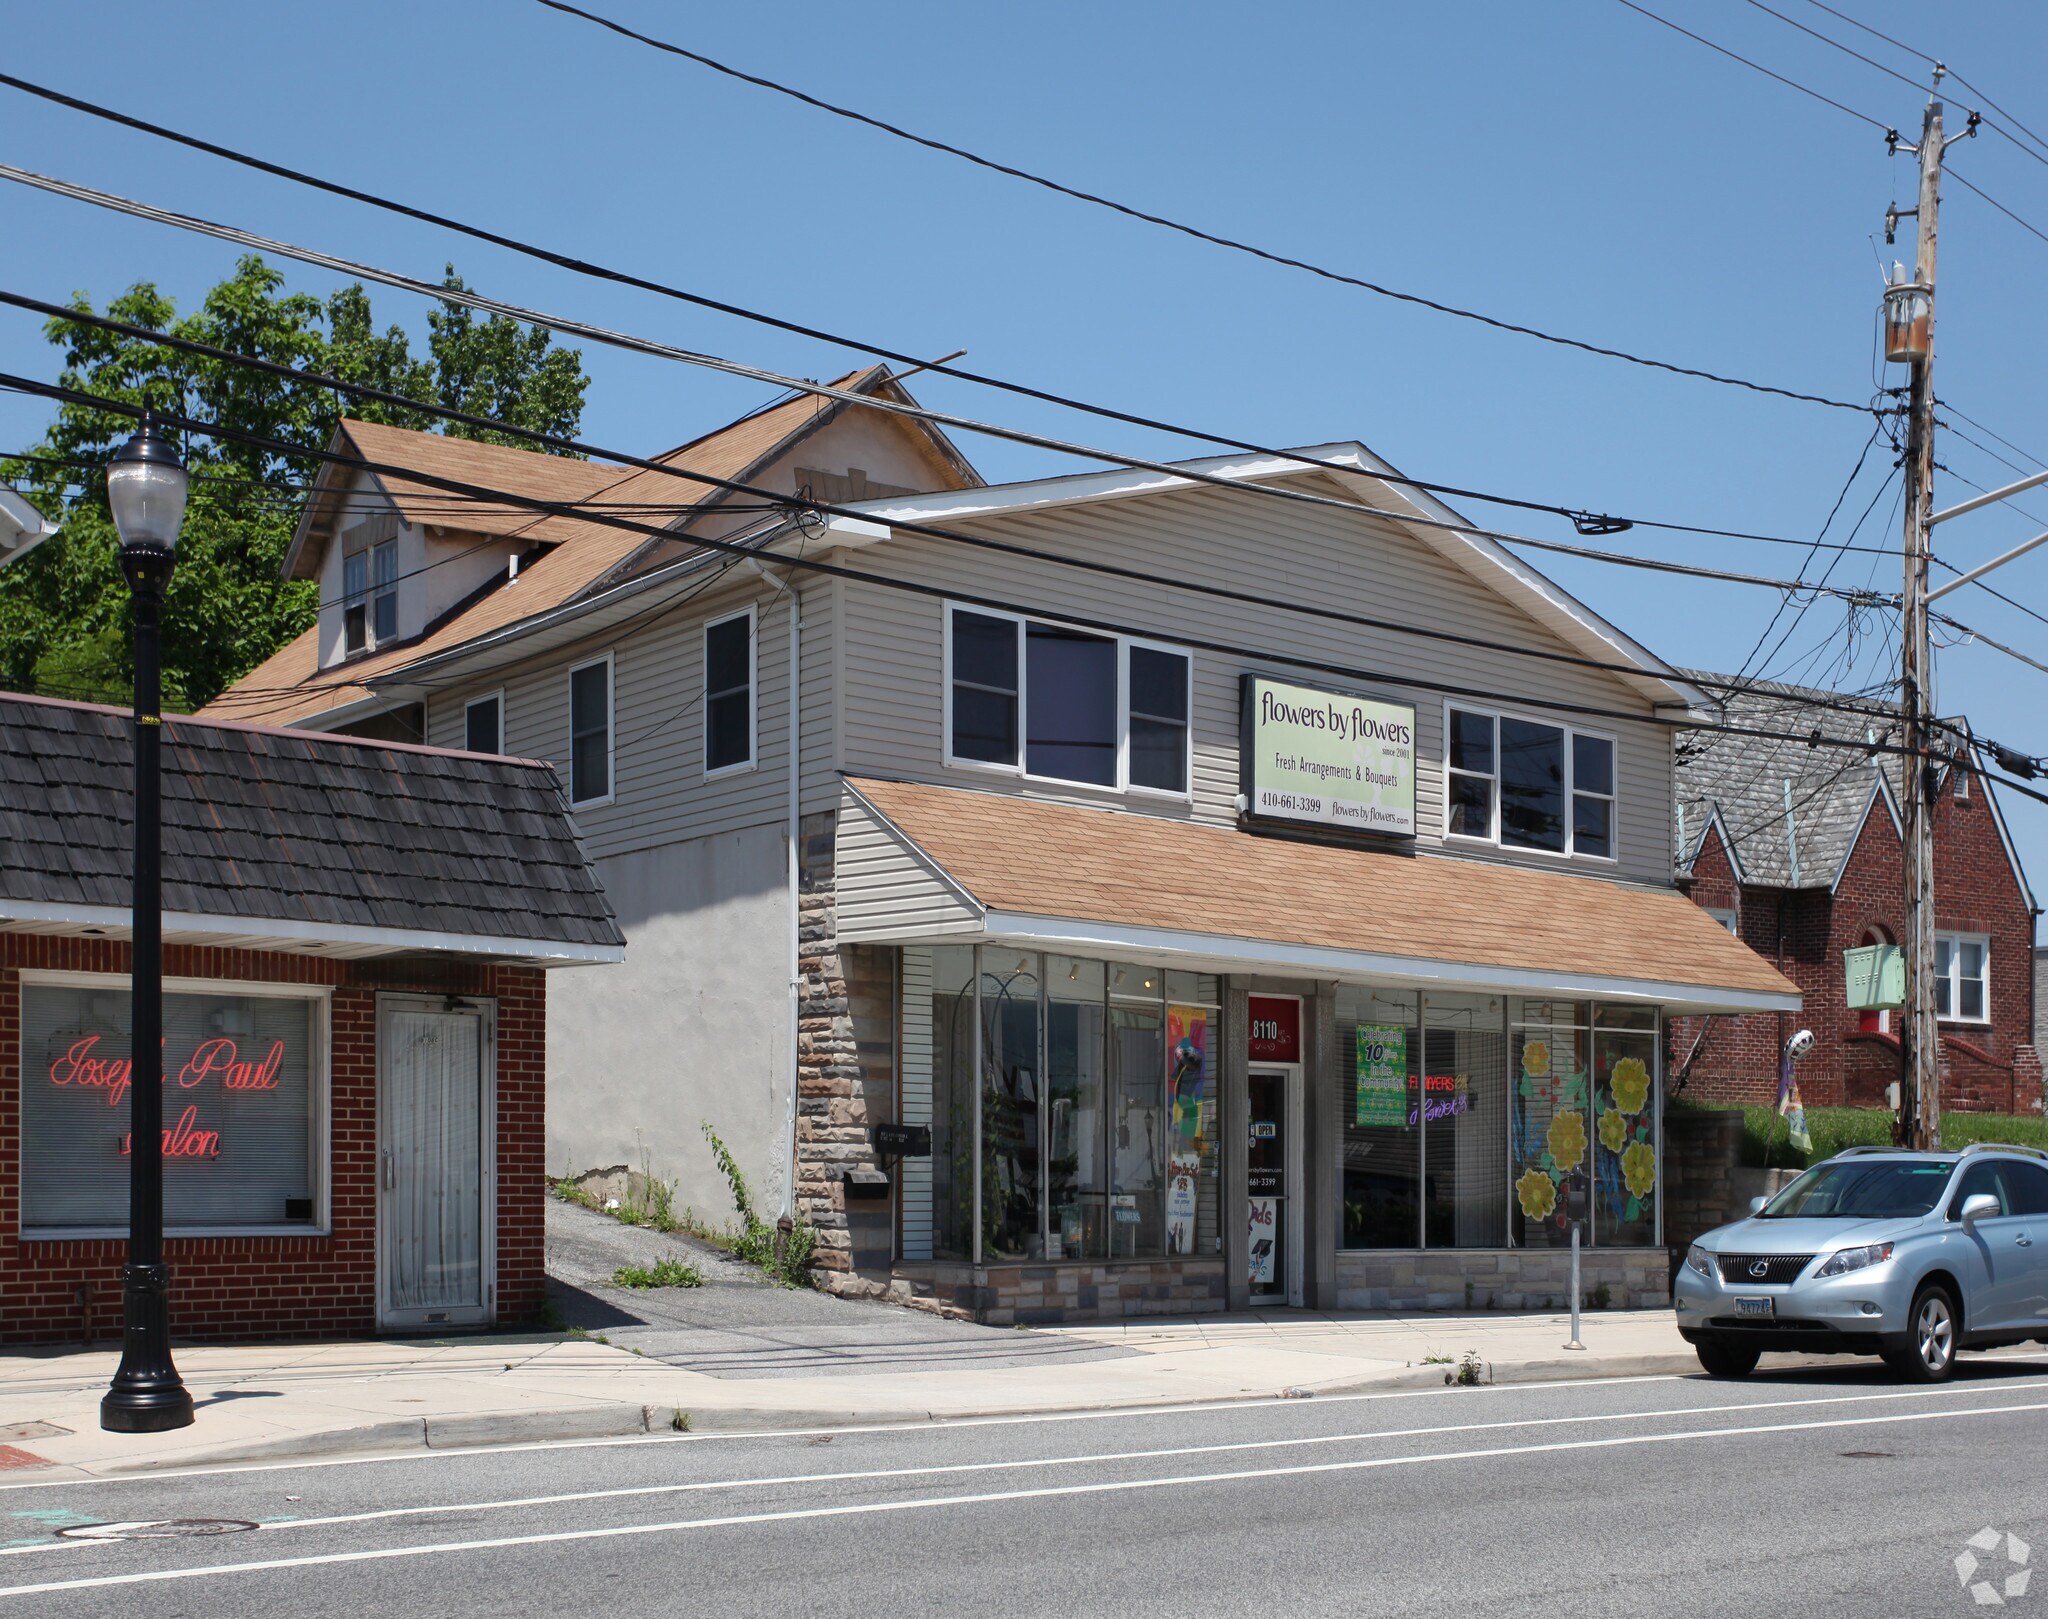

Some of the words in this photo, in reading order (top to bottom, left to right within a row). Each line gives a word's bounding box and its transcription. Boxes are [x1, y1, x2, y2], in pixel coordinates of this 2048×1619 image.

[1261, 691, 1325, 729] flowers
[1328, 703, 1349, 740] by
[1351, 707, 1410, 745] flowers
[1382, 746, 1395, 757] since
[1396, 749, 1410, 760] 2001
[1275, 752, 1296, 771] Fresh
[1300, 756, 1352, 781] Arrangements
[1355, 765, 1361, 781] &
[1365, 767, 1398, 790] Bouquets
[1261, 792, 1321, 813] 410-661-3399
[1253, 1019, 1277, 1040] 8110
[1360, 1027, 1403, 1046] Celebrating
[1365, 1043, 1384, 1061] 10
[50, 1034, 165, 1106] Josep
[179, 1037, 285, 1089] Paul
[1379, 1063, 1392, 1076] the
[1408, 1075, 1455, 1092] FLWERS
[1258, 1124, 1273, 1136] OPEN
